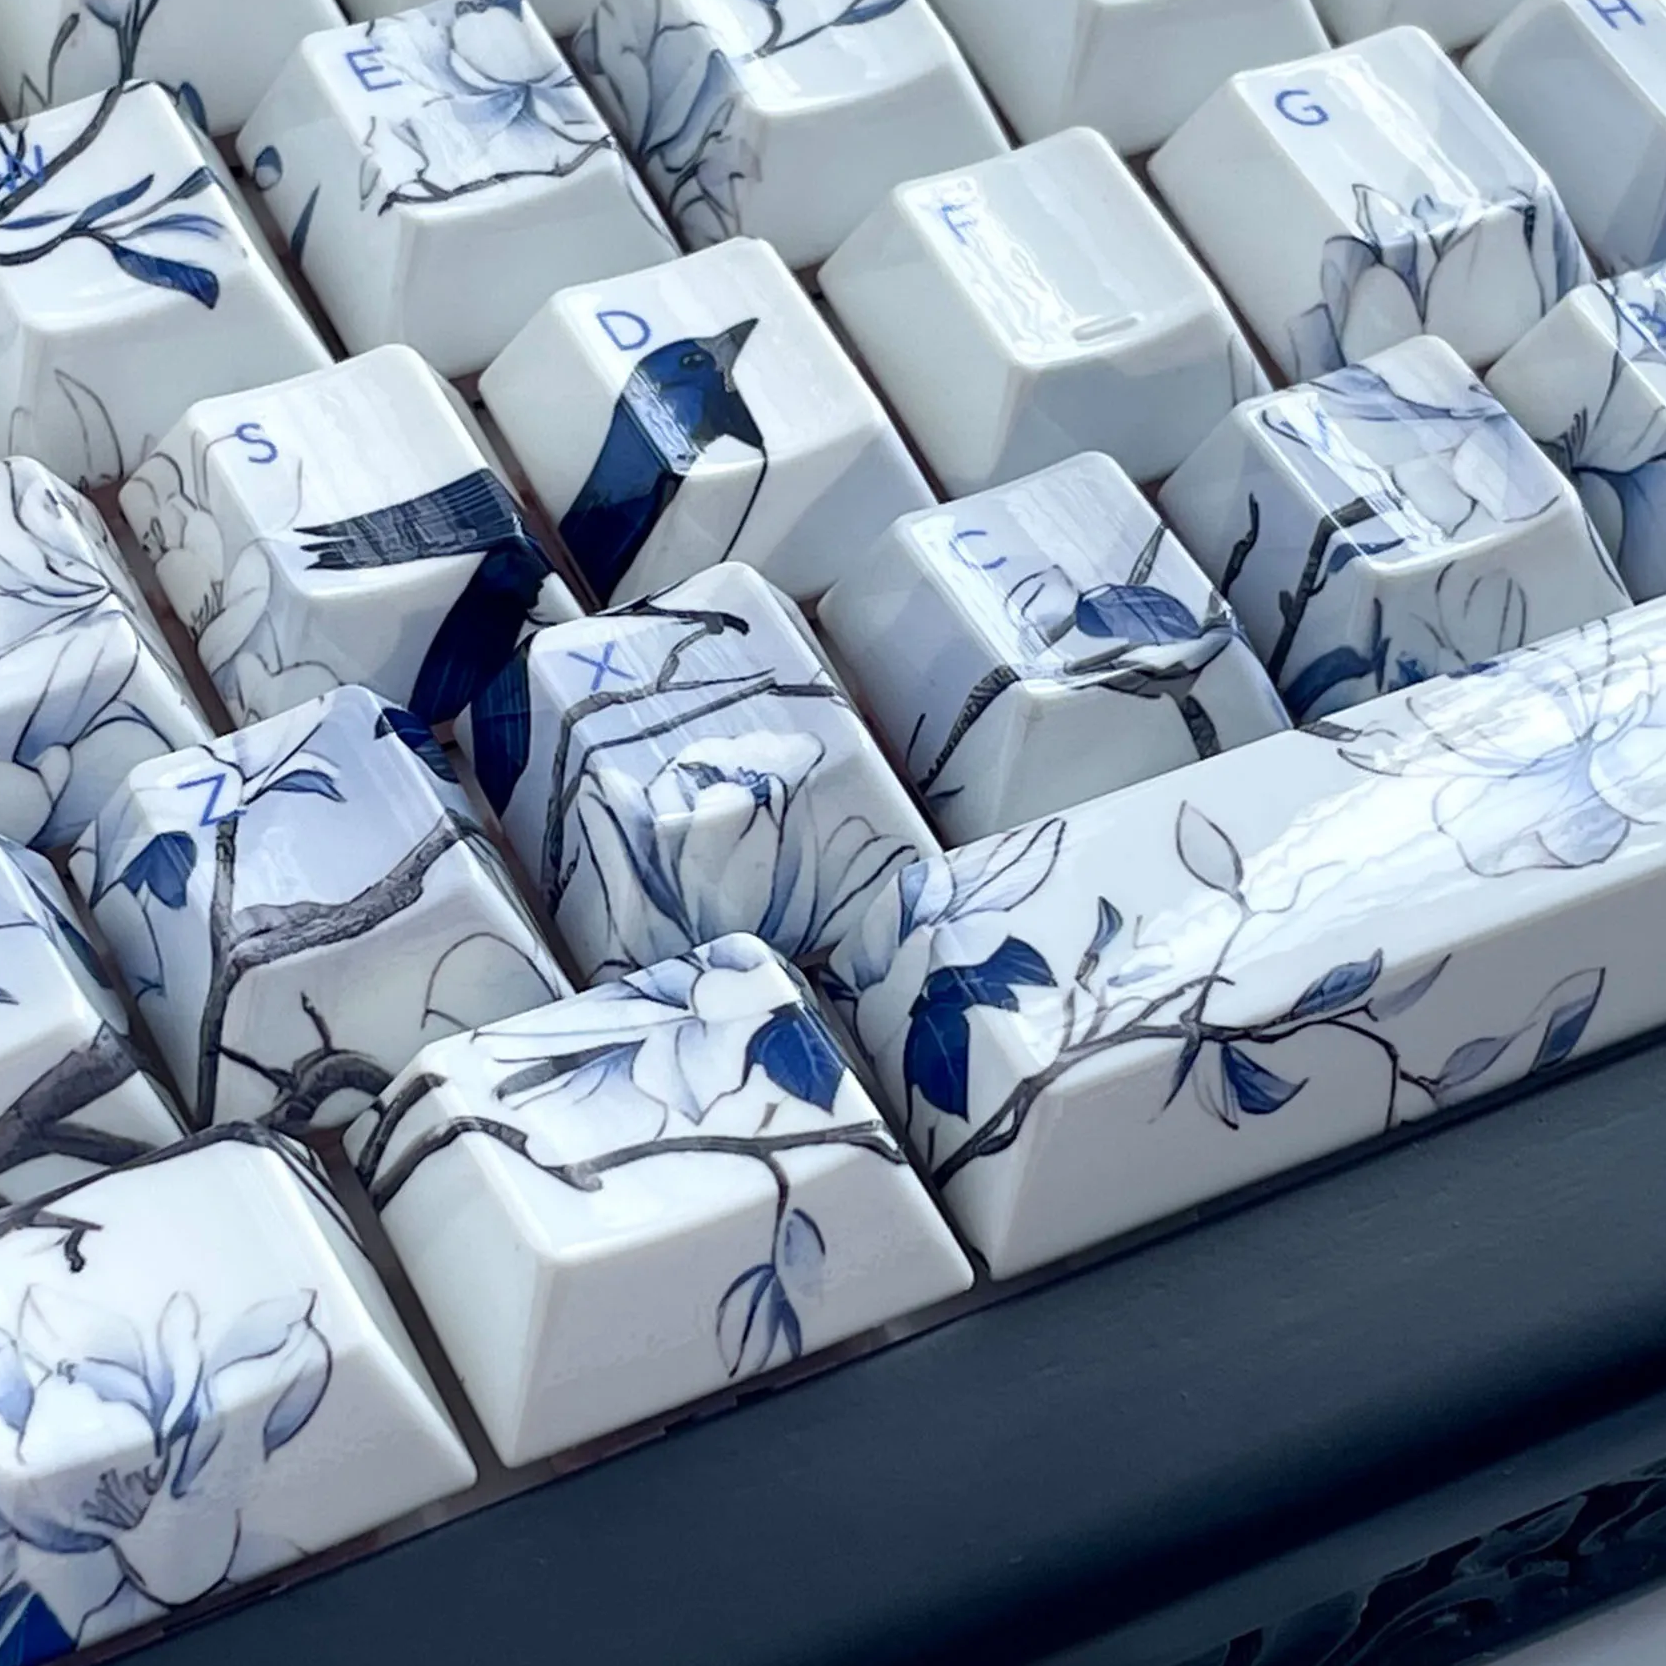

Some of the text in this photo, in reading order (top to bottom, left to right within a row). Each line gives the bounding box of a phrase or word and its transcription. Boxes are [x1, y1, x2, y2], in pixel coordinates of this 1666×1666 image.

[345, 45, 395, 92] E
[1274, 89, 1330, 127] G
[938, 201, 976, 244] F
[596, 310, 651, 352] D
[234, 421, 279, 466] S
[950, 529, 1009, 570] C
[569, 641, 626, 691] X
[175, 772, 247, 828] Z
